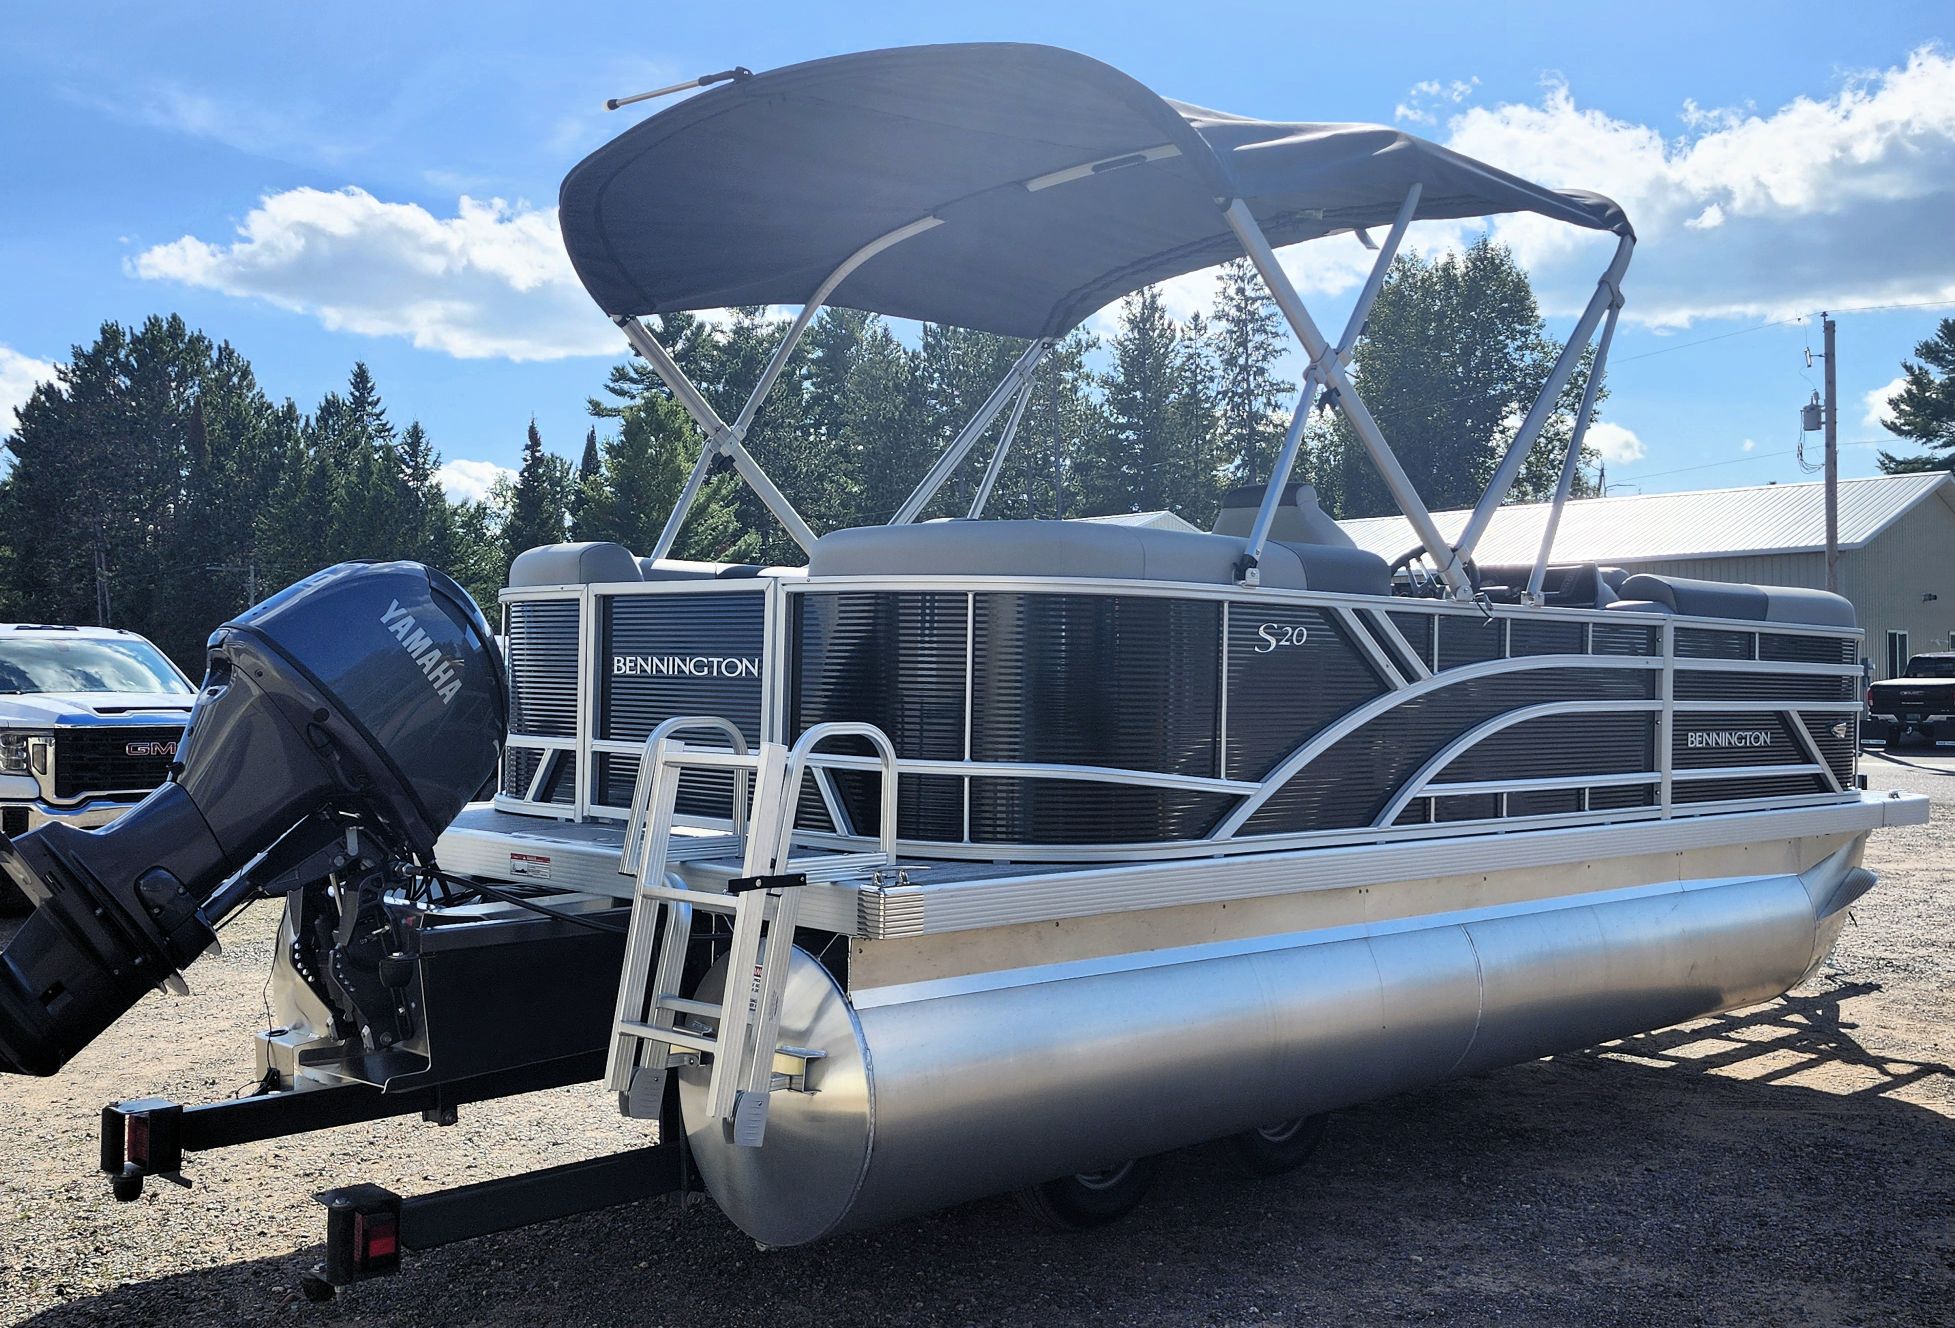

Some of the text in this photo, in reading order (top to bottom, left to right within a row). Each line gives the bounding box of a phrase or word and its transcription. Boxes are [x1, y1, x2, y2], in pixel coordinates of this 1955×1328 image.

[1254, 622, 1308, 653] S20
[379, 599, 463, 705] YAMAHA
[613, 656, 760, 677] BENNINGTON
[126, 741, 177, 756] GM
[1687, 731, 1771, 748] BENNINGTON
